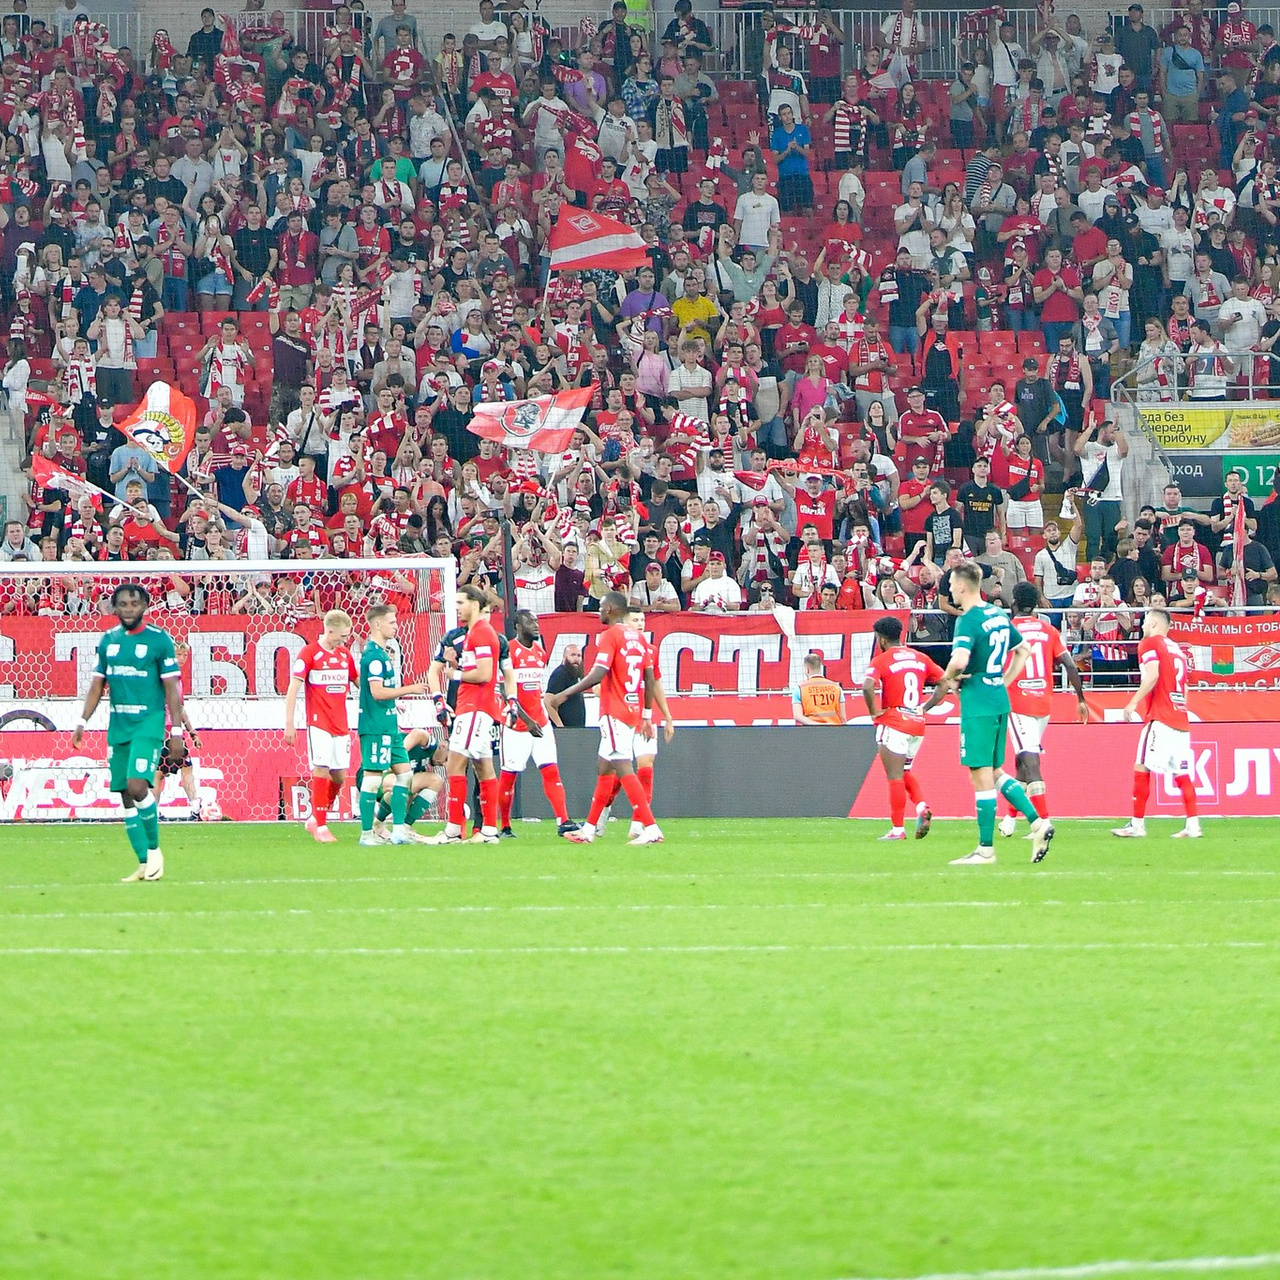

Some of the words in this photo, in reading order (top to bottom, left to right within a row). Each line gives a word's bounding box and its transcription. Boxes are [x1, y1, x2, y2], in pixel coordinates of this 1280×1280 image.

[1164, 411, 1185, 422] без
[1221, 624, 1242, 635] МЫ
[1245, 623, 1253, 634] С
[624, 655, 643, 692] 5
[808, 685, 837, 694] STEWARD
[904, 671, 919, 708] 8
[810, 693, 835, 708] T219
